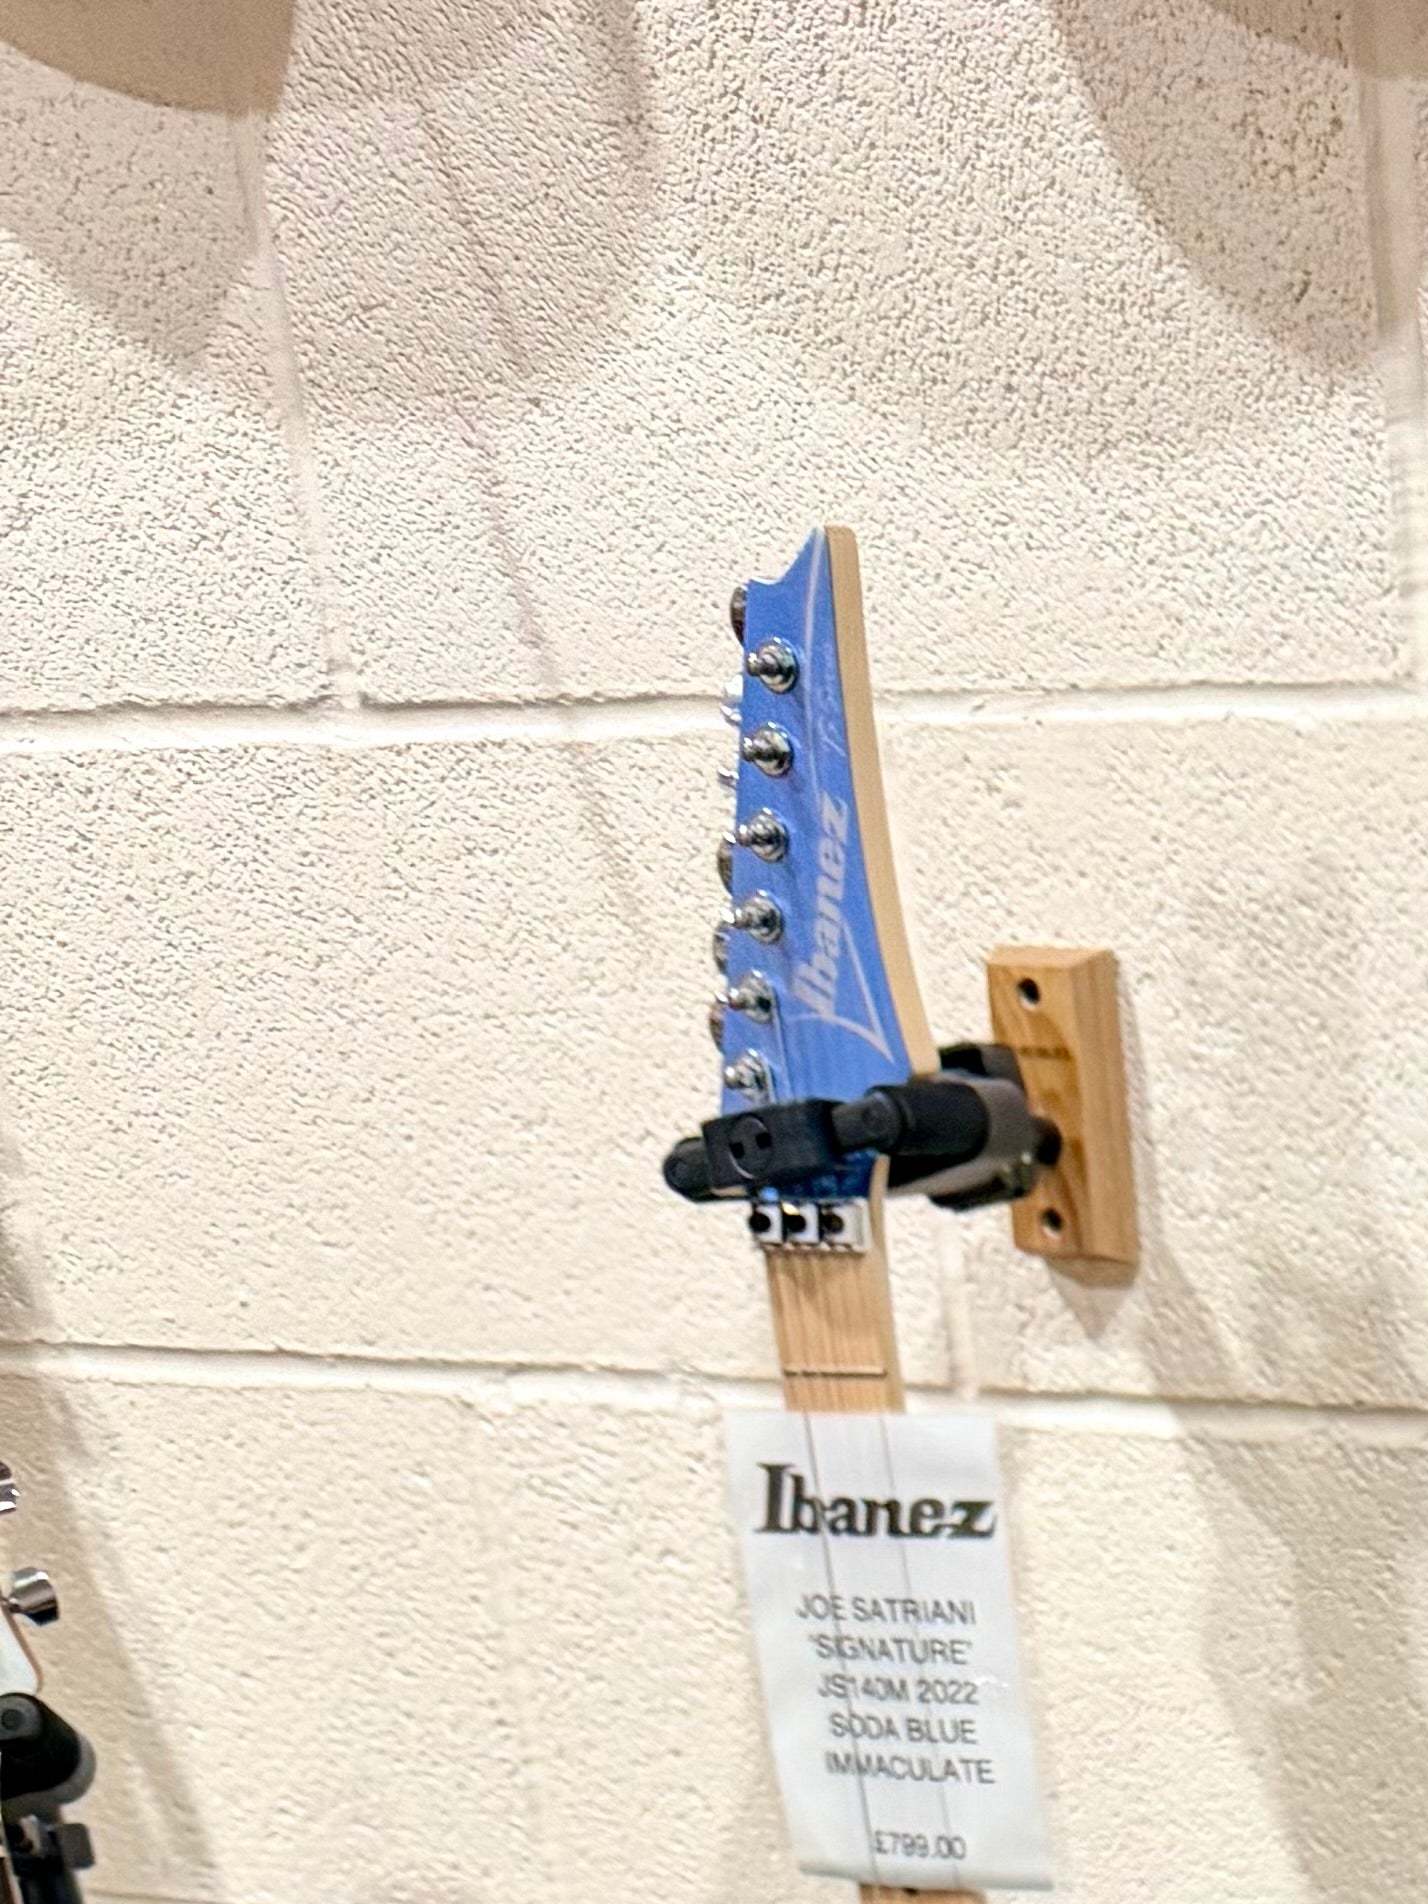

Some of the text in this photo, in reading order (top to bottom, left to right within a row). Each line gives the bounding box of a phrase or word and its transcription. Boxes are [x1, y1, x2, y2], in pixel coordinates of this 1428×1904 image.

[793, 790, 850, 1018] Ibanez
[755, 1462, 998, 1539] Ibanez
[796, 1594, 976, 1625] JOE SATRIANI
[819, 1673, 978, 1705] JS140M 2022
[829, 1711, 977, 1744] SODA BLUE
[826, 1751, 995, 1784] IMMACULATE
[873, 1830, 966, 1860] £799.00
